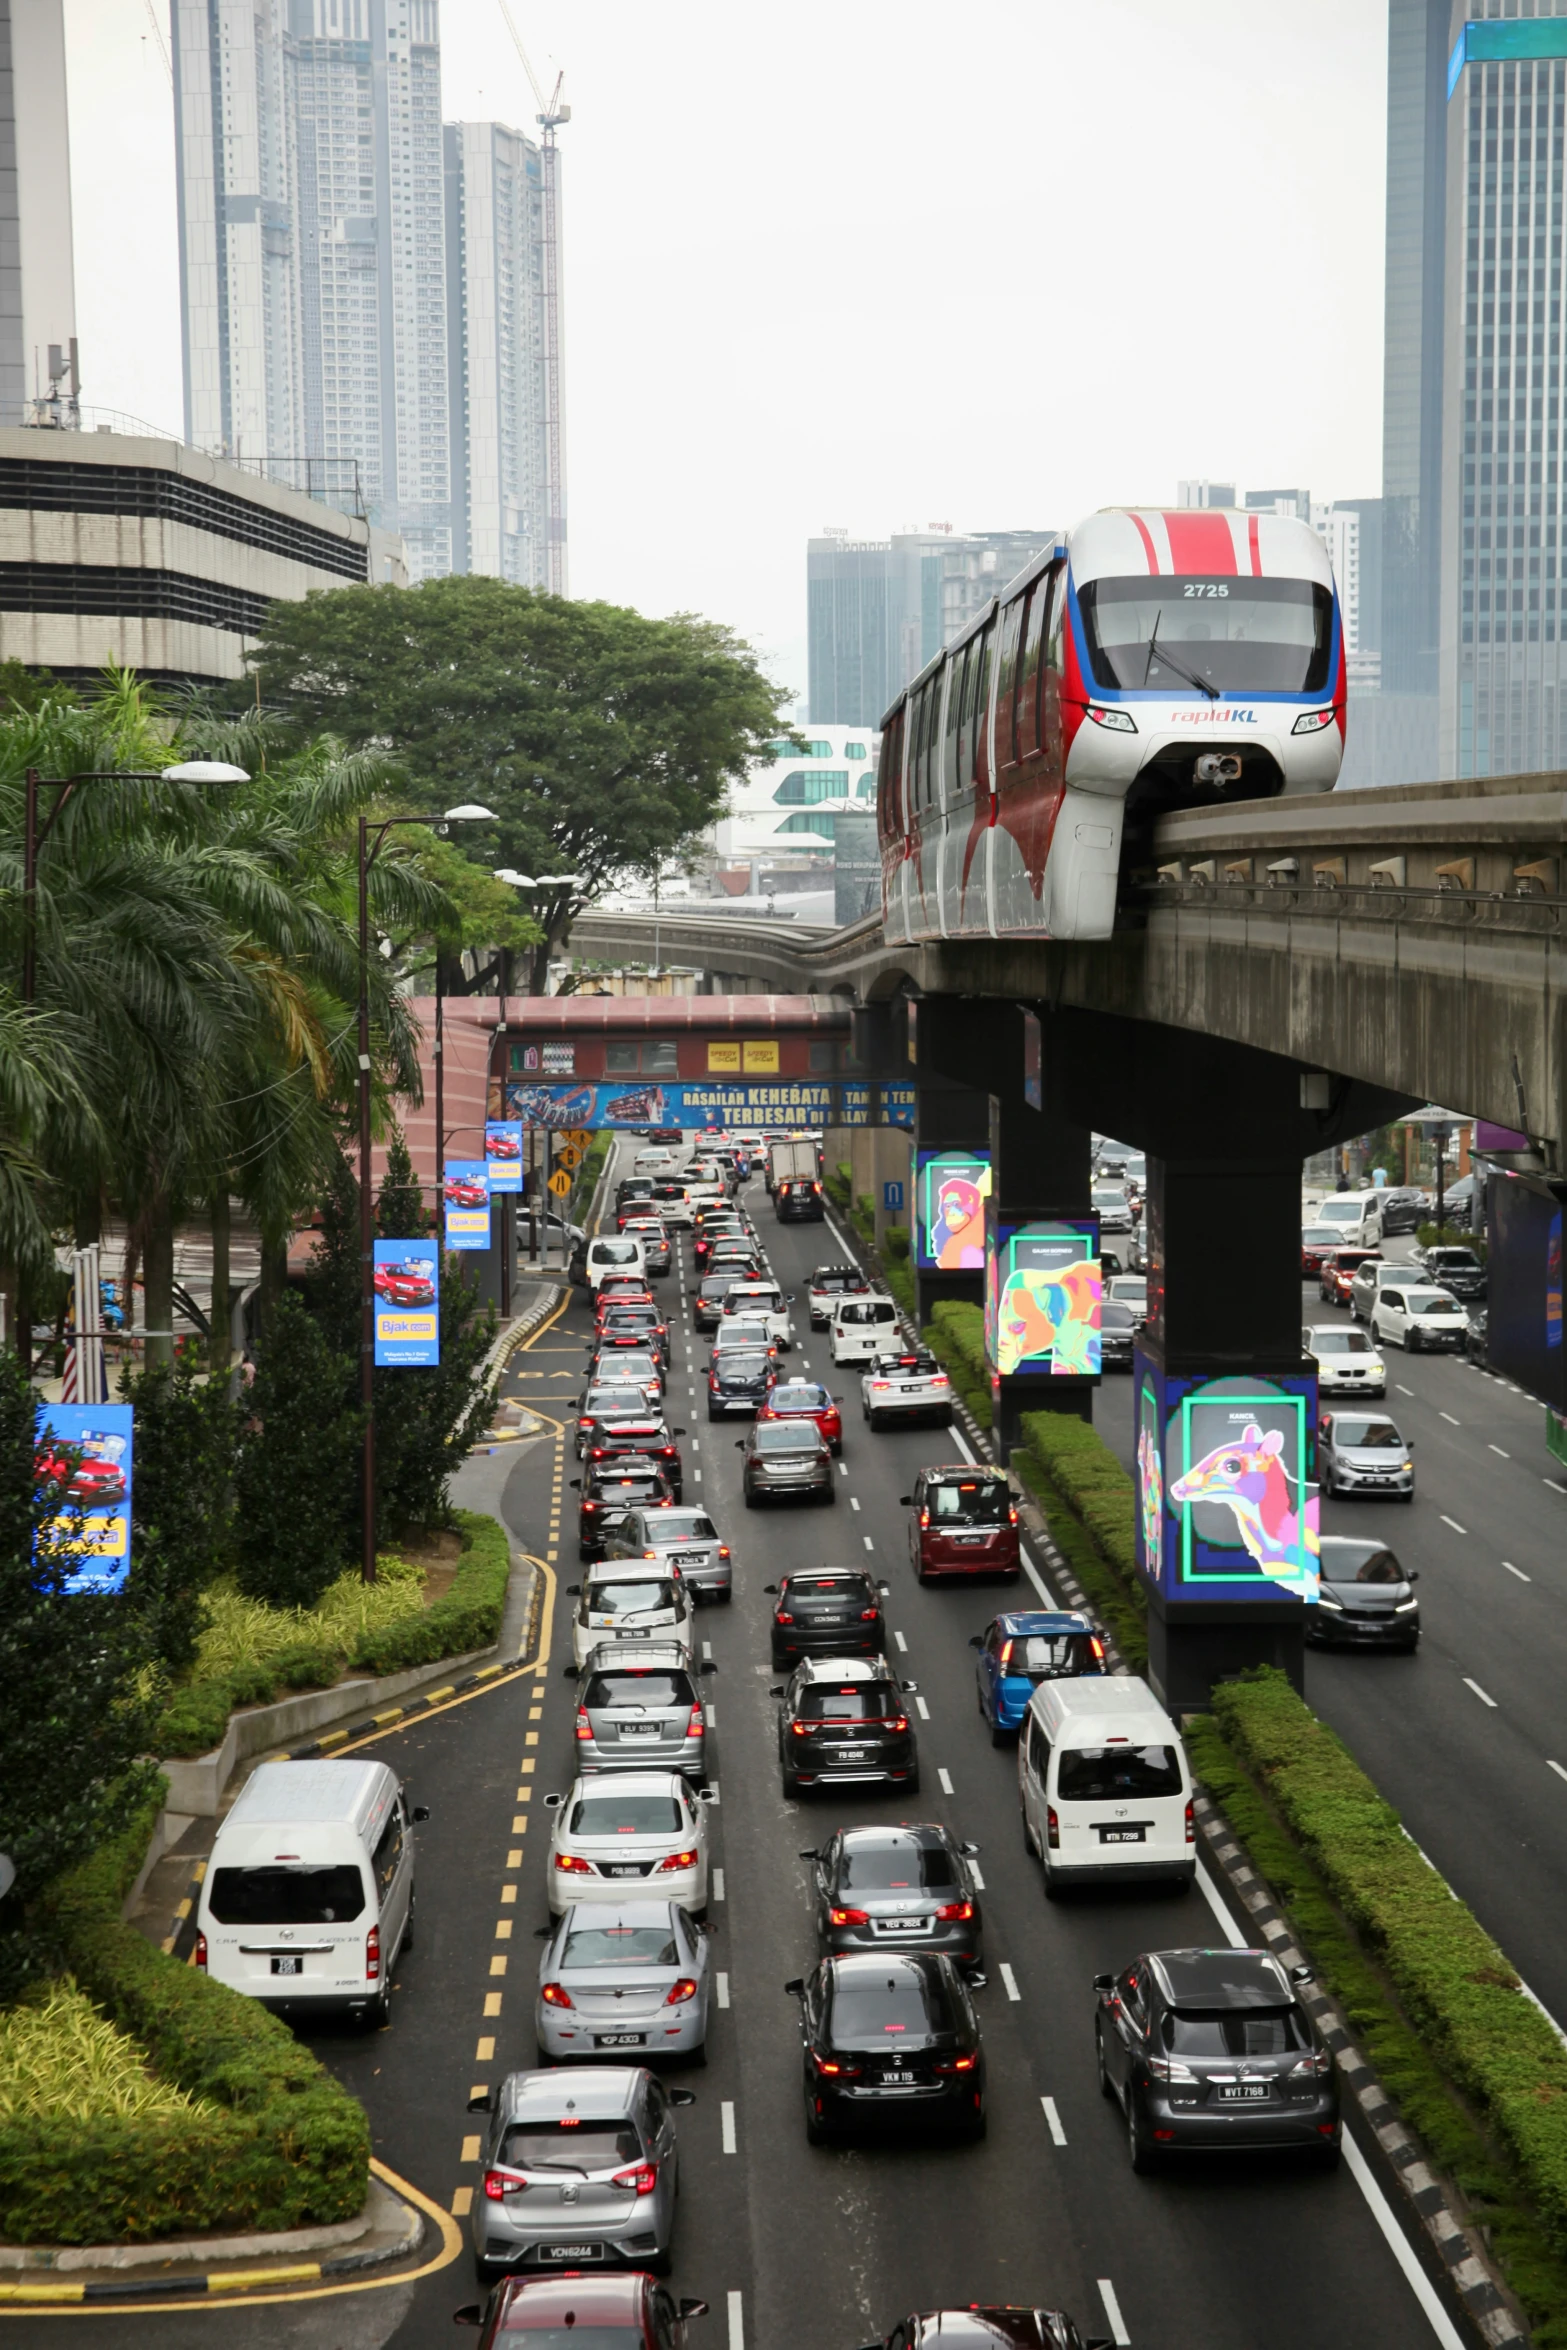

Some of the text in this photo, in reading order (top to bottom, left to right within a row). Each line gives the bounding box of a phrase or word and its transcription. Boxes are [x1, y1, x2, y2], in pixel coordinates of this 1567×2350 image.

[1183, 584, 1229, 598] 2725
[1171, 709, 1258, 725] rapidKL
[682, 1092, 745, 1106] RASAILAH
[748, 1088, 832, 1106] KEHEBATA
[846, 1091, 889, 1104] TAMN
[722, 1107, 890, 1125] TERBESAR DI ALAYA
[382, 1321, 409, 1334] Bjak
[1106, 1833, 1120, 1841] WTN
[618, 2034, 640, 2044] 4303
[882, 2071, 913, 2082] VKW 119
[1224, 2086, 1264, 2097] WVT 7168
